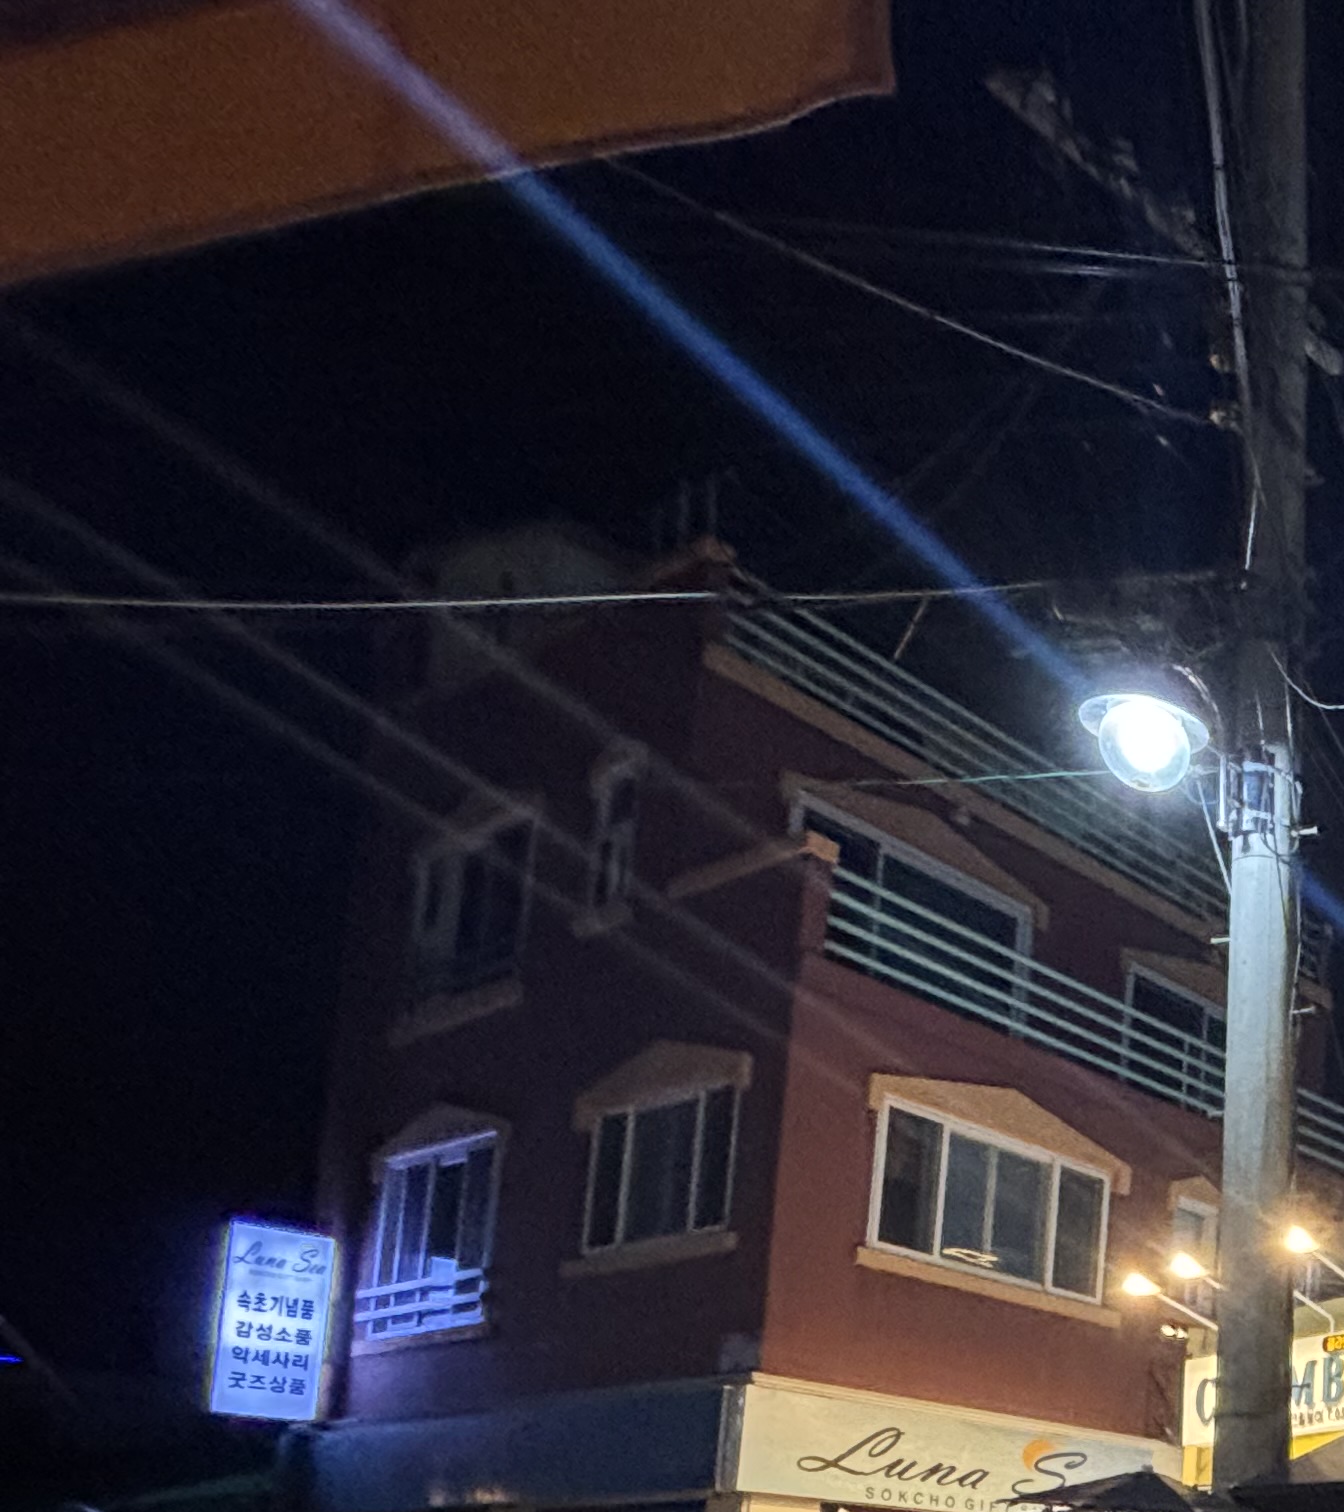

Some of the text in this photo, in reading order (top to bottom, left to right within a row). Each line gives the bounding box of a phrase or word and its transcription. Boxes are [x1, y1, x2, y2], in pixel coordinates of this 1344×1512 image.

[234, 1241, 327, 1275] Luna Sea
[236, 1290, 315, 1320] 속초기념품
[235, 1320, 312, 1346] 감성소품
[231, 1345, 309, 1372] 악세사리
[227, 1371, 306, 1395] 굿즈상품
[797, 1426, 990, 1490] Luna
[865, 1486, 956, 1508] SOKCHO
